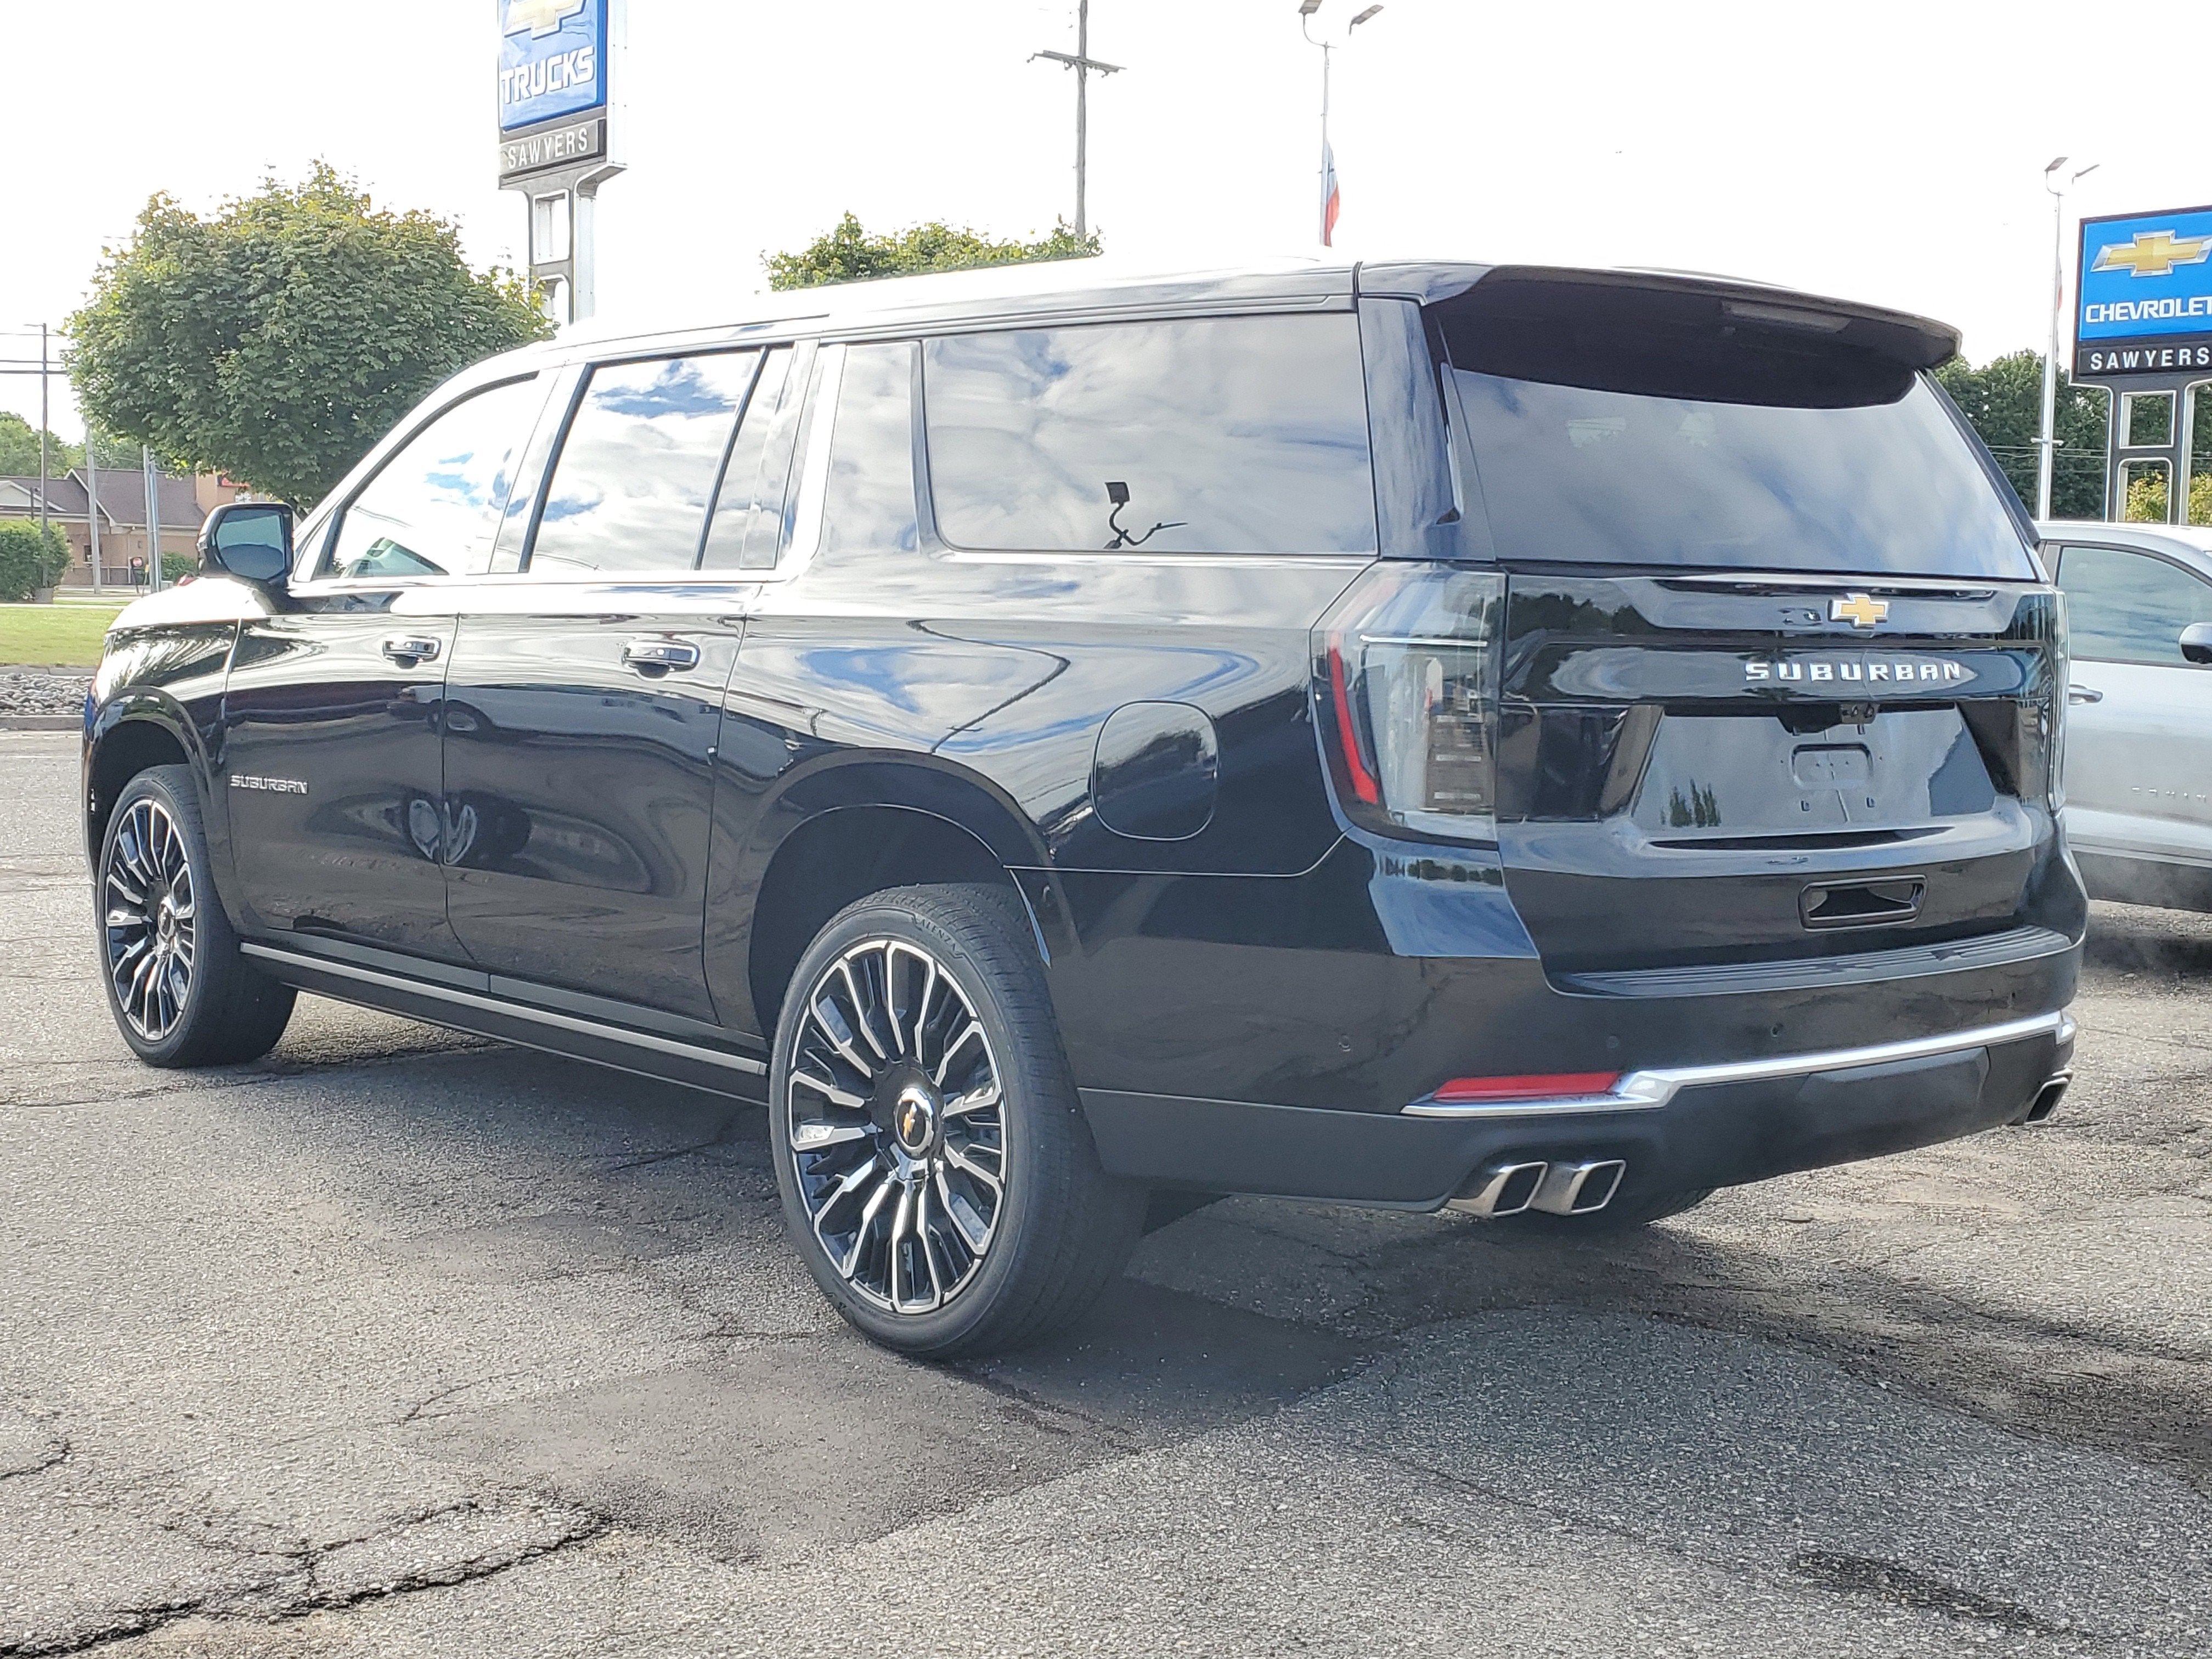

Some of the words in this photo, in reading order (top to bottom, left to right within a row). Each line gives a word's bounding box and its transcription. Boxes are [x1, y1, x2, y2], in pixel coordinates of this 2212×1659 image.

[500, 45, 595, 104] TRUCKS
[507, 128, 588, 169] SAWYERS
[2085, 296, 2212, 323] CHEVROLET
[2090, 347, 2210, 371] SAWYERS
[1745, 662, 1961, 681] SUBURBAN
[230, 775, 308, 795] SUBURBAN
